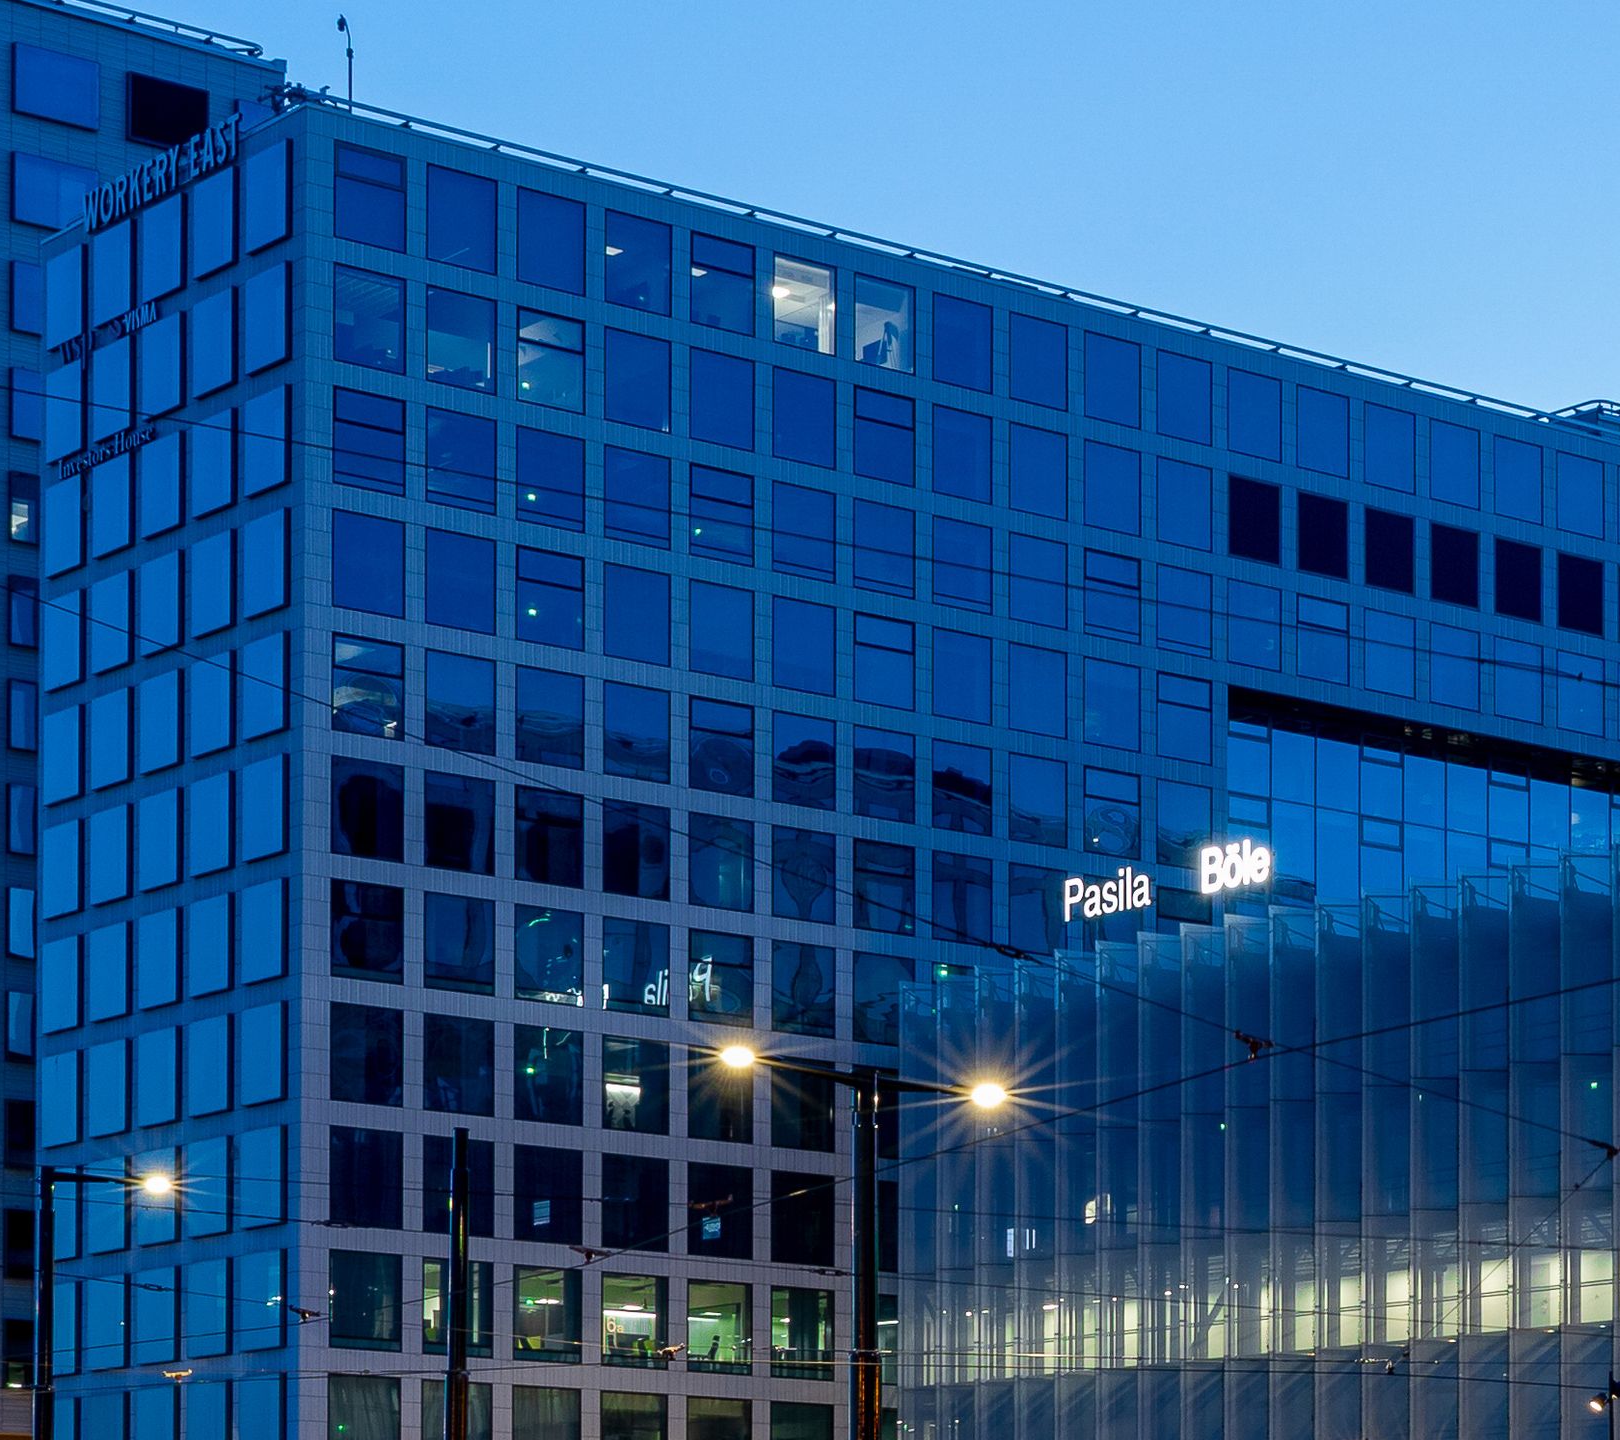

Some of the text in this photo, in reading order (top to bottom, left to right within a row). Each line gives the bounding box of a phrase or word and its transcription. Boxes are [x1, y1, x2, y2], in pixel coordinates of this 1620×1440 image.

[83, 113, 243, 233] WORKERY EAST
[1064, 867, 1152, 922] Pasila
[1200, 839, 1271, 895] Böle
